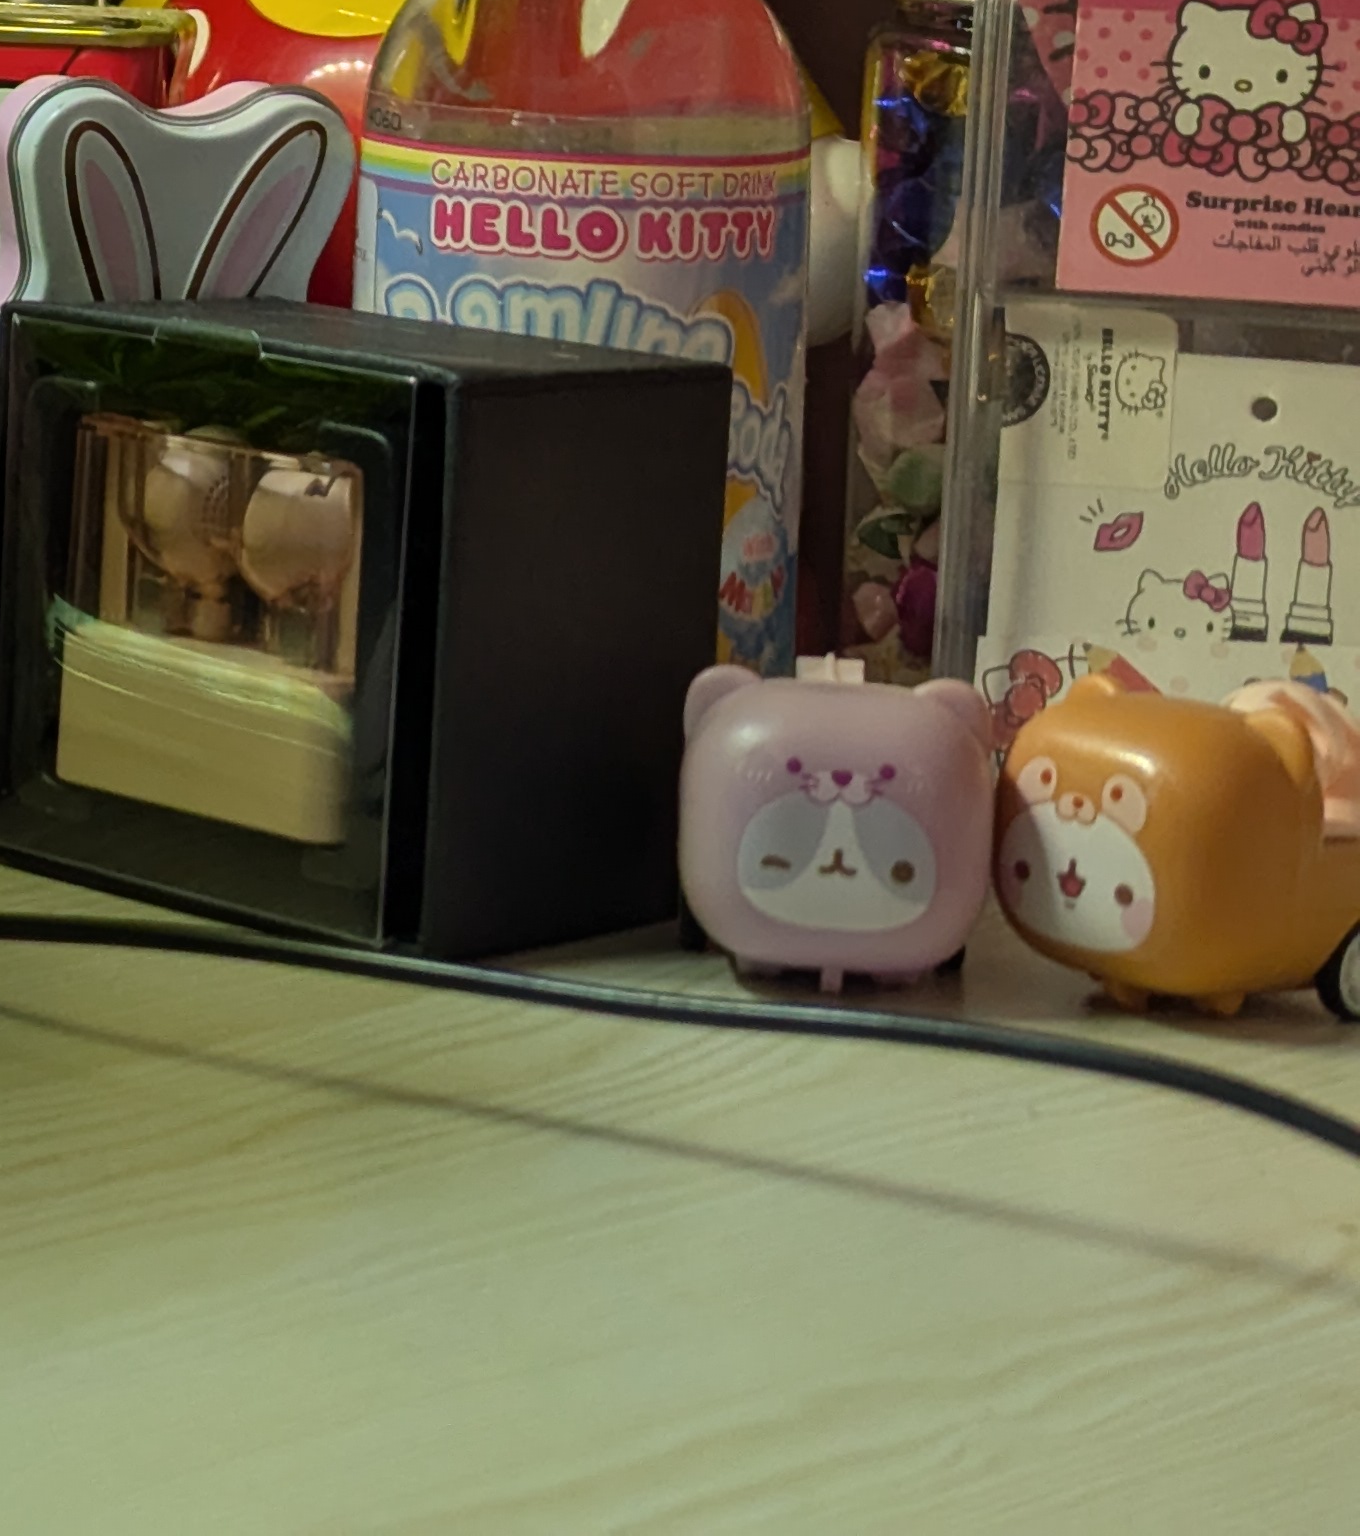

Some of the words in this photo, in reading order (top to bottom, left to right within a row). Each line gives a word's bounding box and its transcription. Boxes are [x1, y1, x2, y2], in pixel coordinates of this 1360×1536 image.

[431, 159, 619, 198] CARBONATE
[630, 170, 714, 199] SOFT
[723, 170, 776, 198] DRINK
[1186, 190, 1297, 214] Surprise
[431, 194, 628, 262] HELLO
[635, 205, 776, 262] KITTY
[1164, 443, 1261, 500] Hello
[1258, 445, 1360, 509] Kitty
